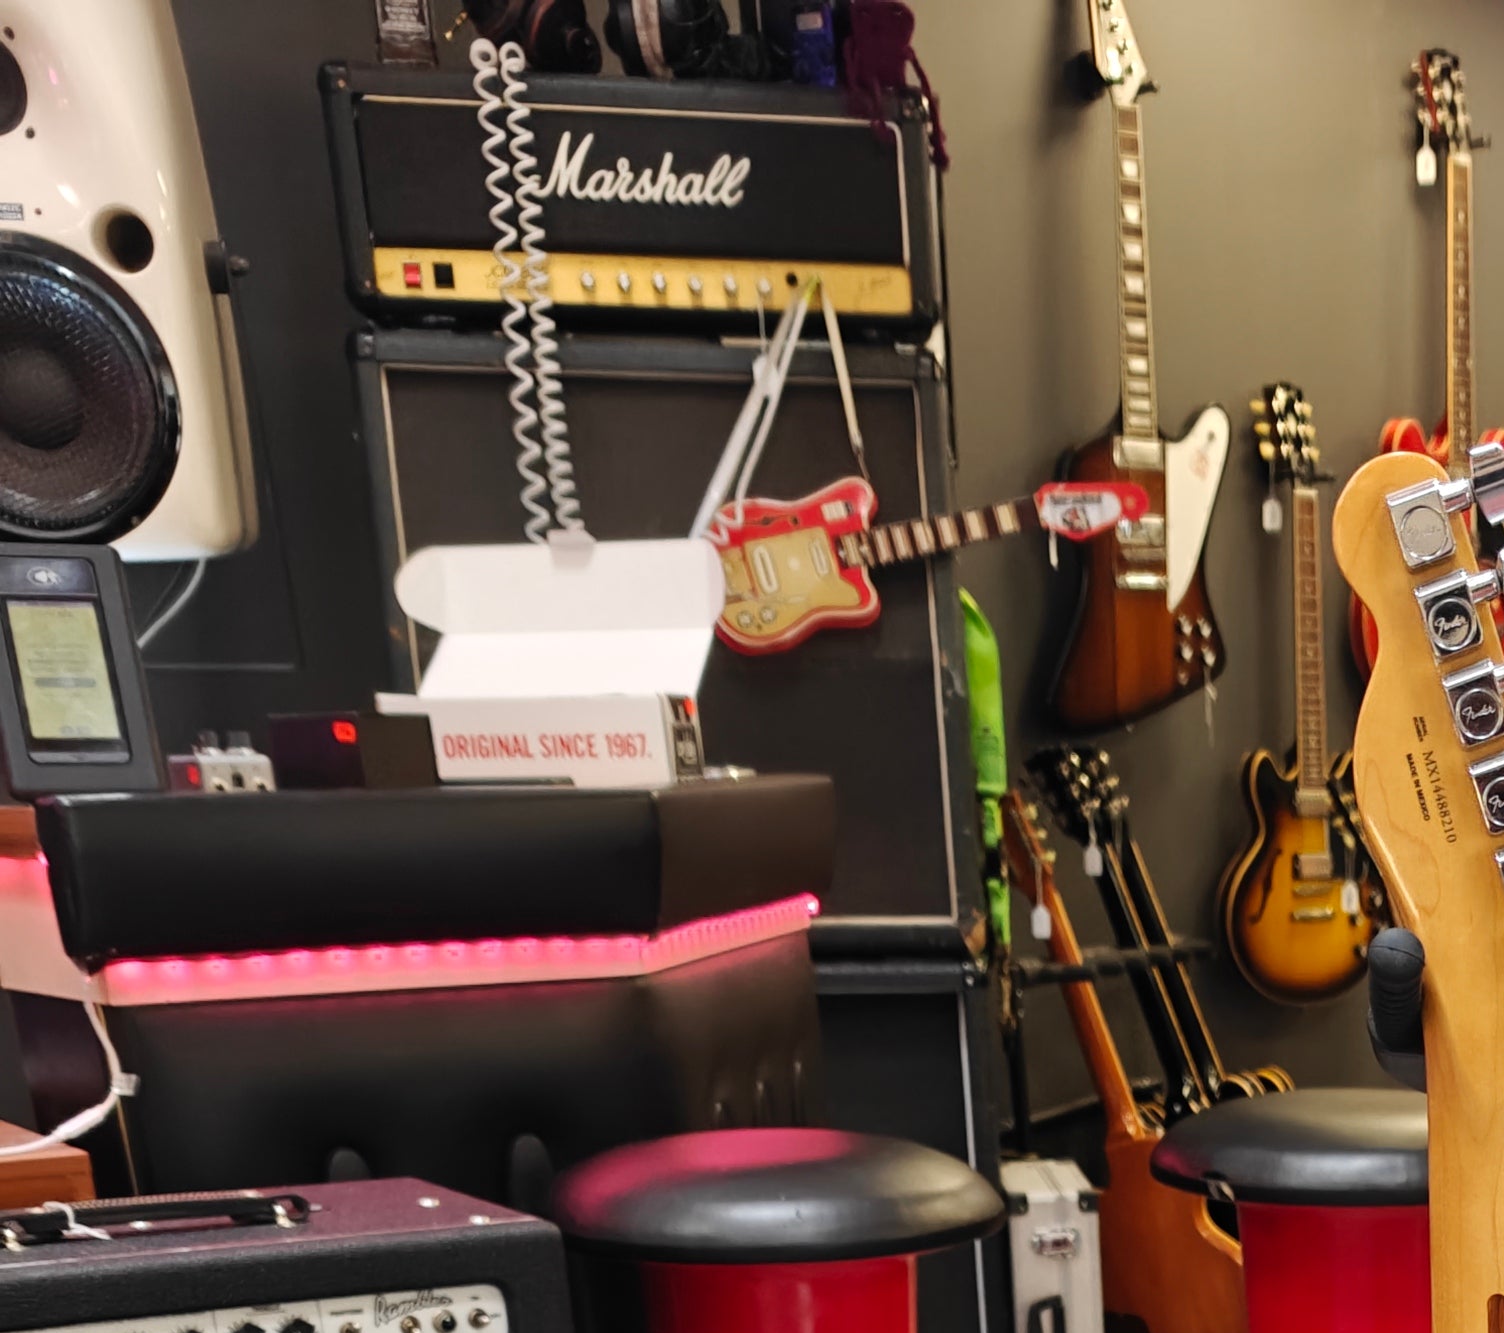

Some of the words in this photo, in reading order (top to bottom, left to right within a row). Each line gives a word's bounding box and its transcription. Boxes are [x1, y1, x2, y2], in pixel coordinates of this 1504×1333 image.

[535, 131, 750, 207] Marshall
[442, 732, 534, 760] ORIGINAL
[538, 732, 598, 759] SINCE
[604, 732, 653, 759] 1967.
[1461, 706, 1495, 723] Fender
[1406, 753, 1419, 778] MADE
[1416, 789, 1431, 822] MEXICO
[1422, 750, 1457, 844] MX14488210
